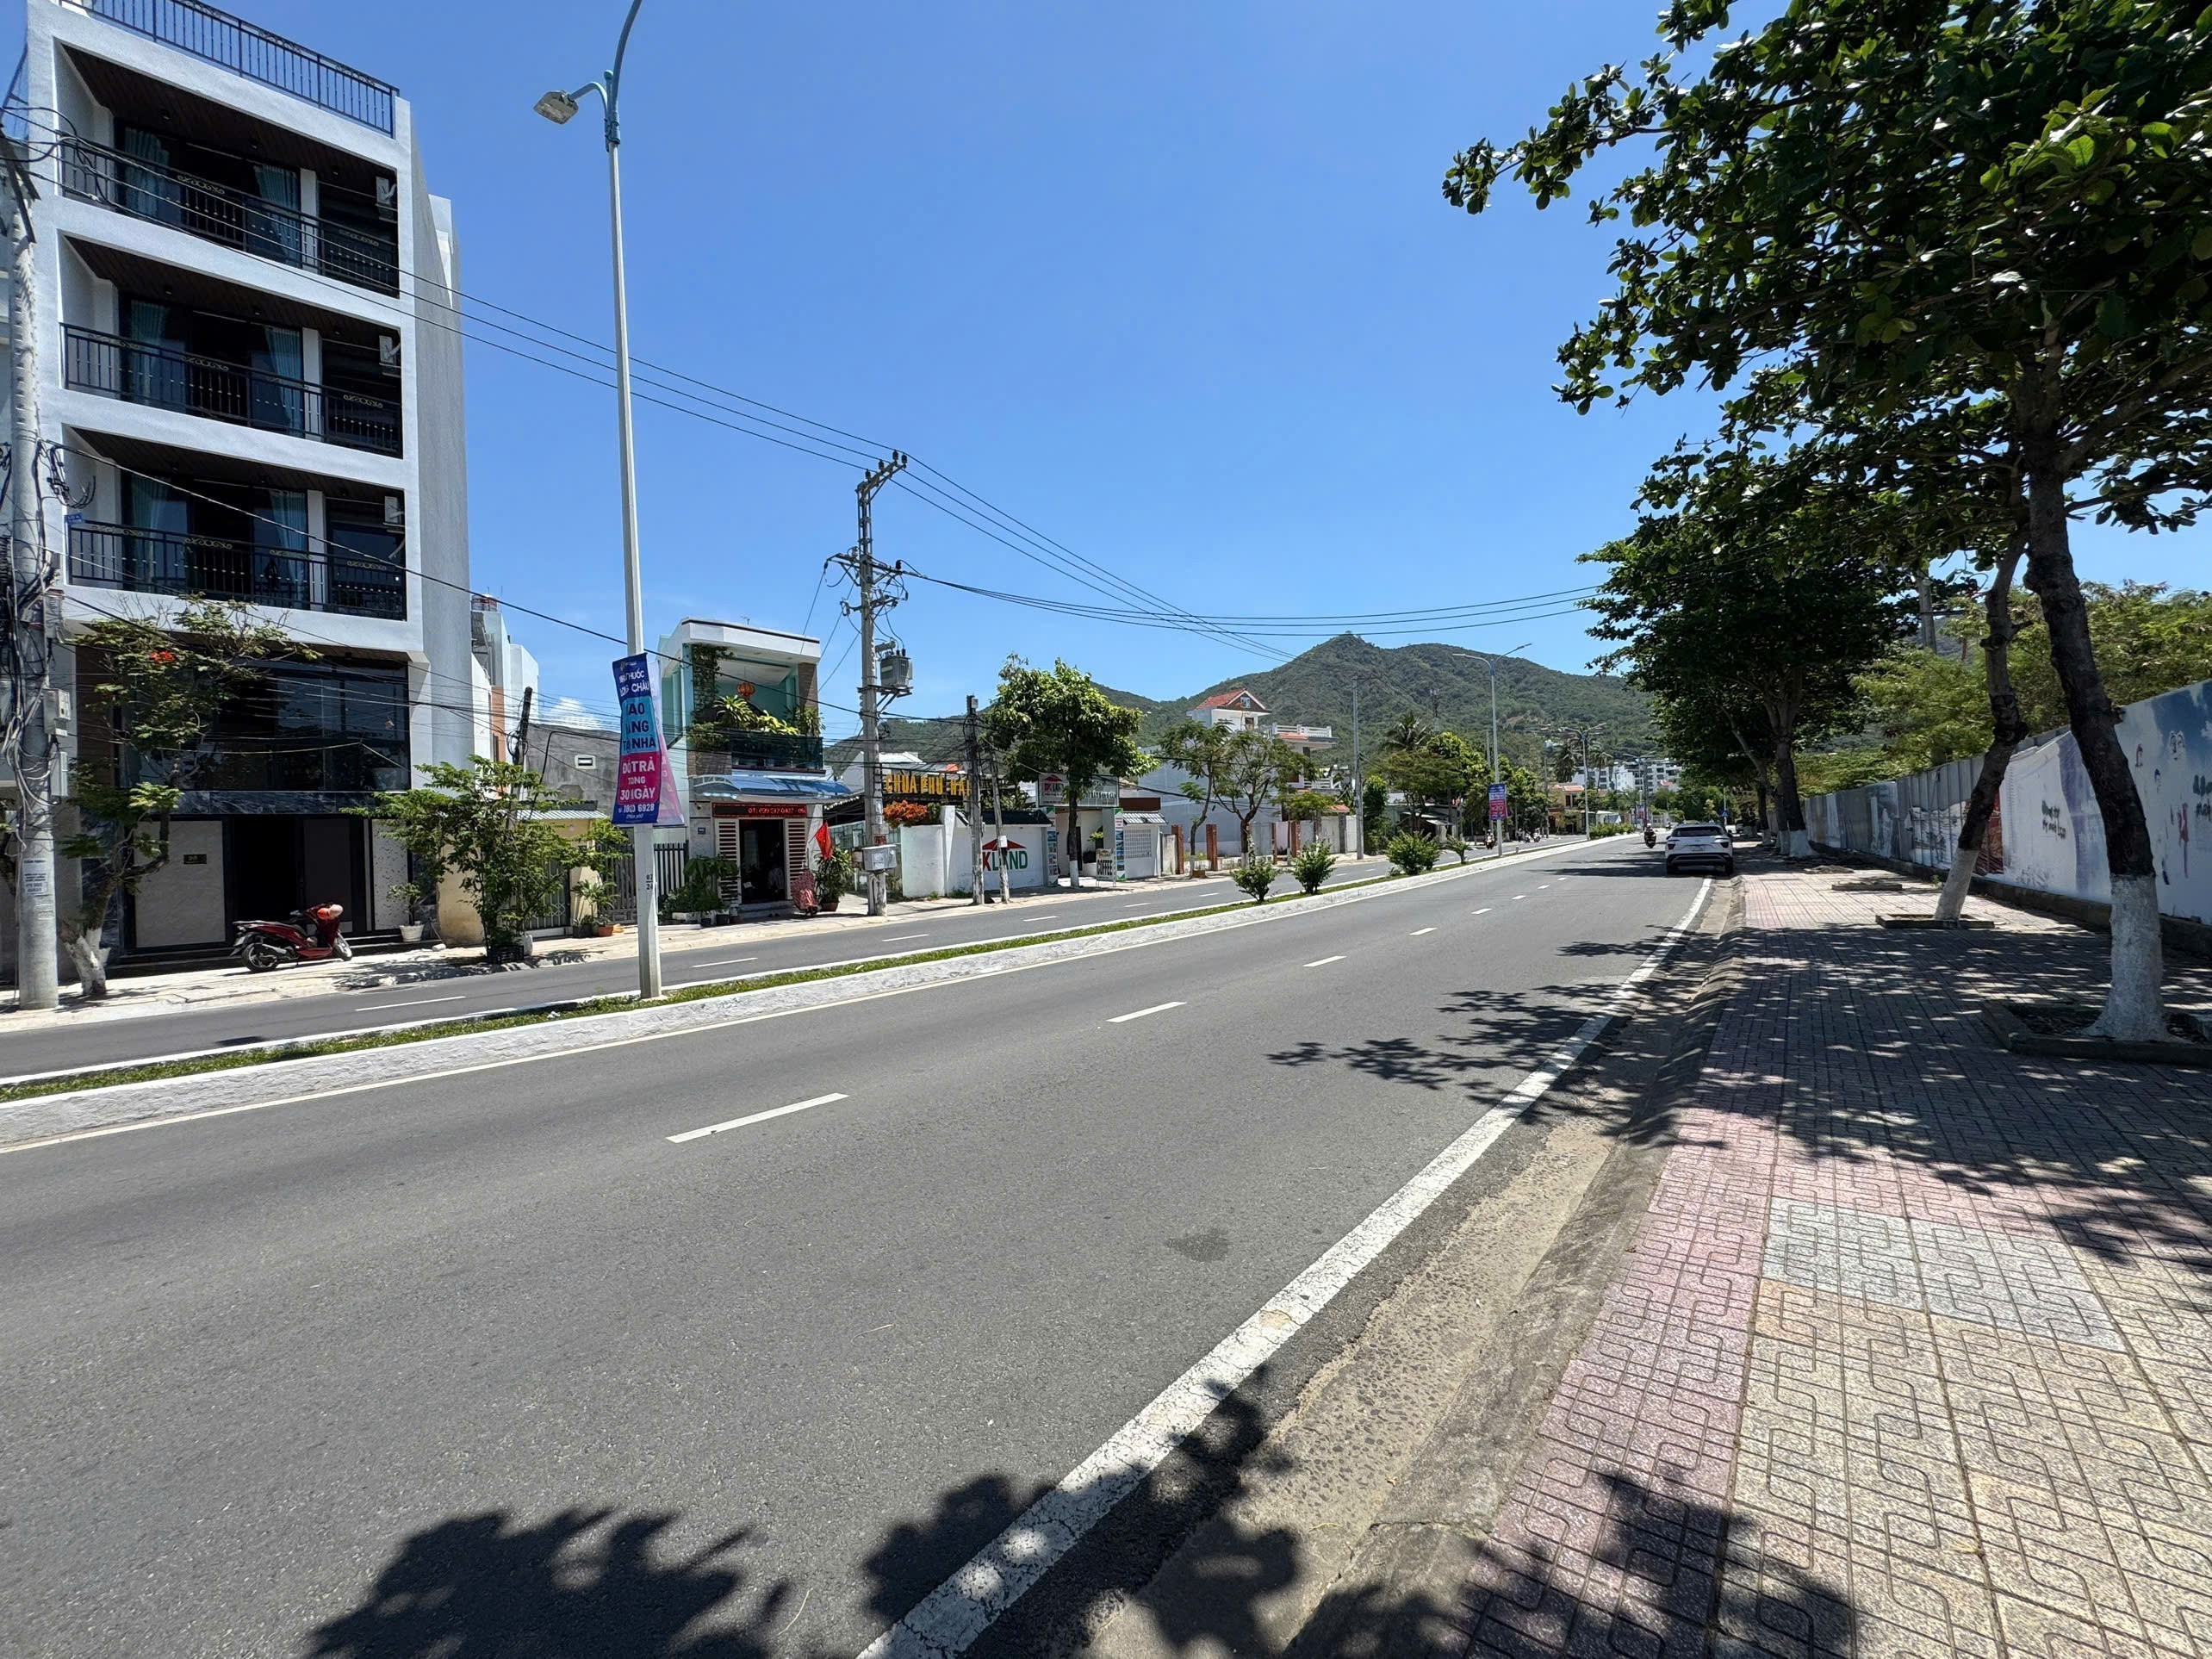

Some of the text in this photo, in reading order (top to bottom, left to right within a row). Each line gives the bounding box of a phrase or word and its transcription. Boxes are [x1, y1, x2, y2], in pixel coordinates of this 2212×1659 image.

[631, 756, 656, 773] TRẢ
[885, 769, 917, 794] CHÙA
[620, 790, 630, 801] 30
[637, 803, 655, 812] 6928
[1097, 859, 1113, 876] COFFEE
